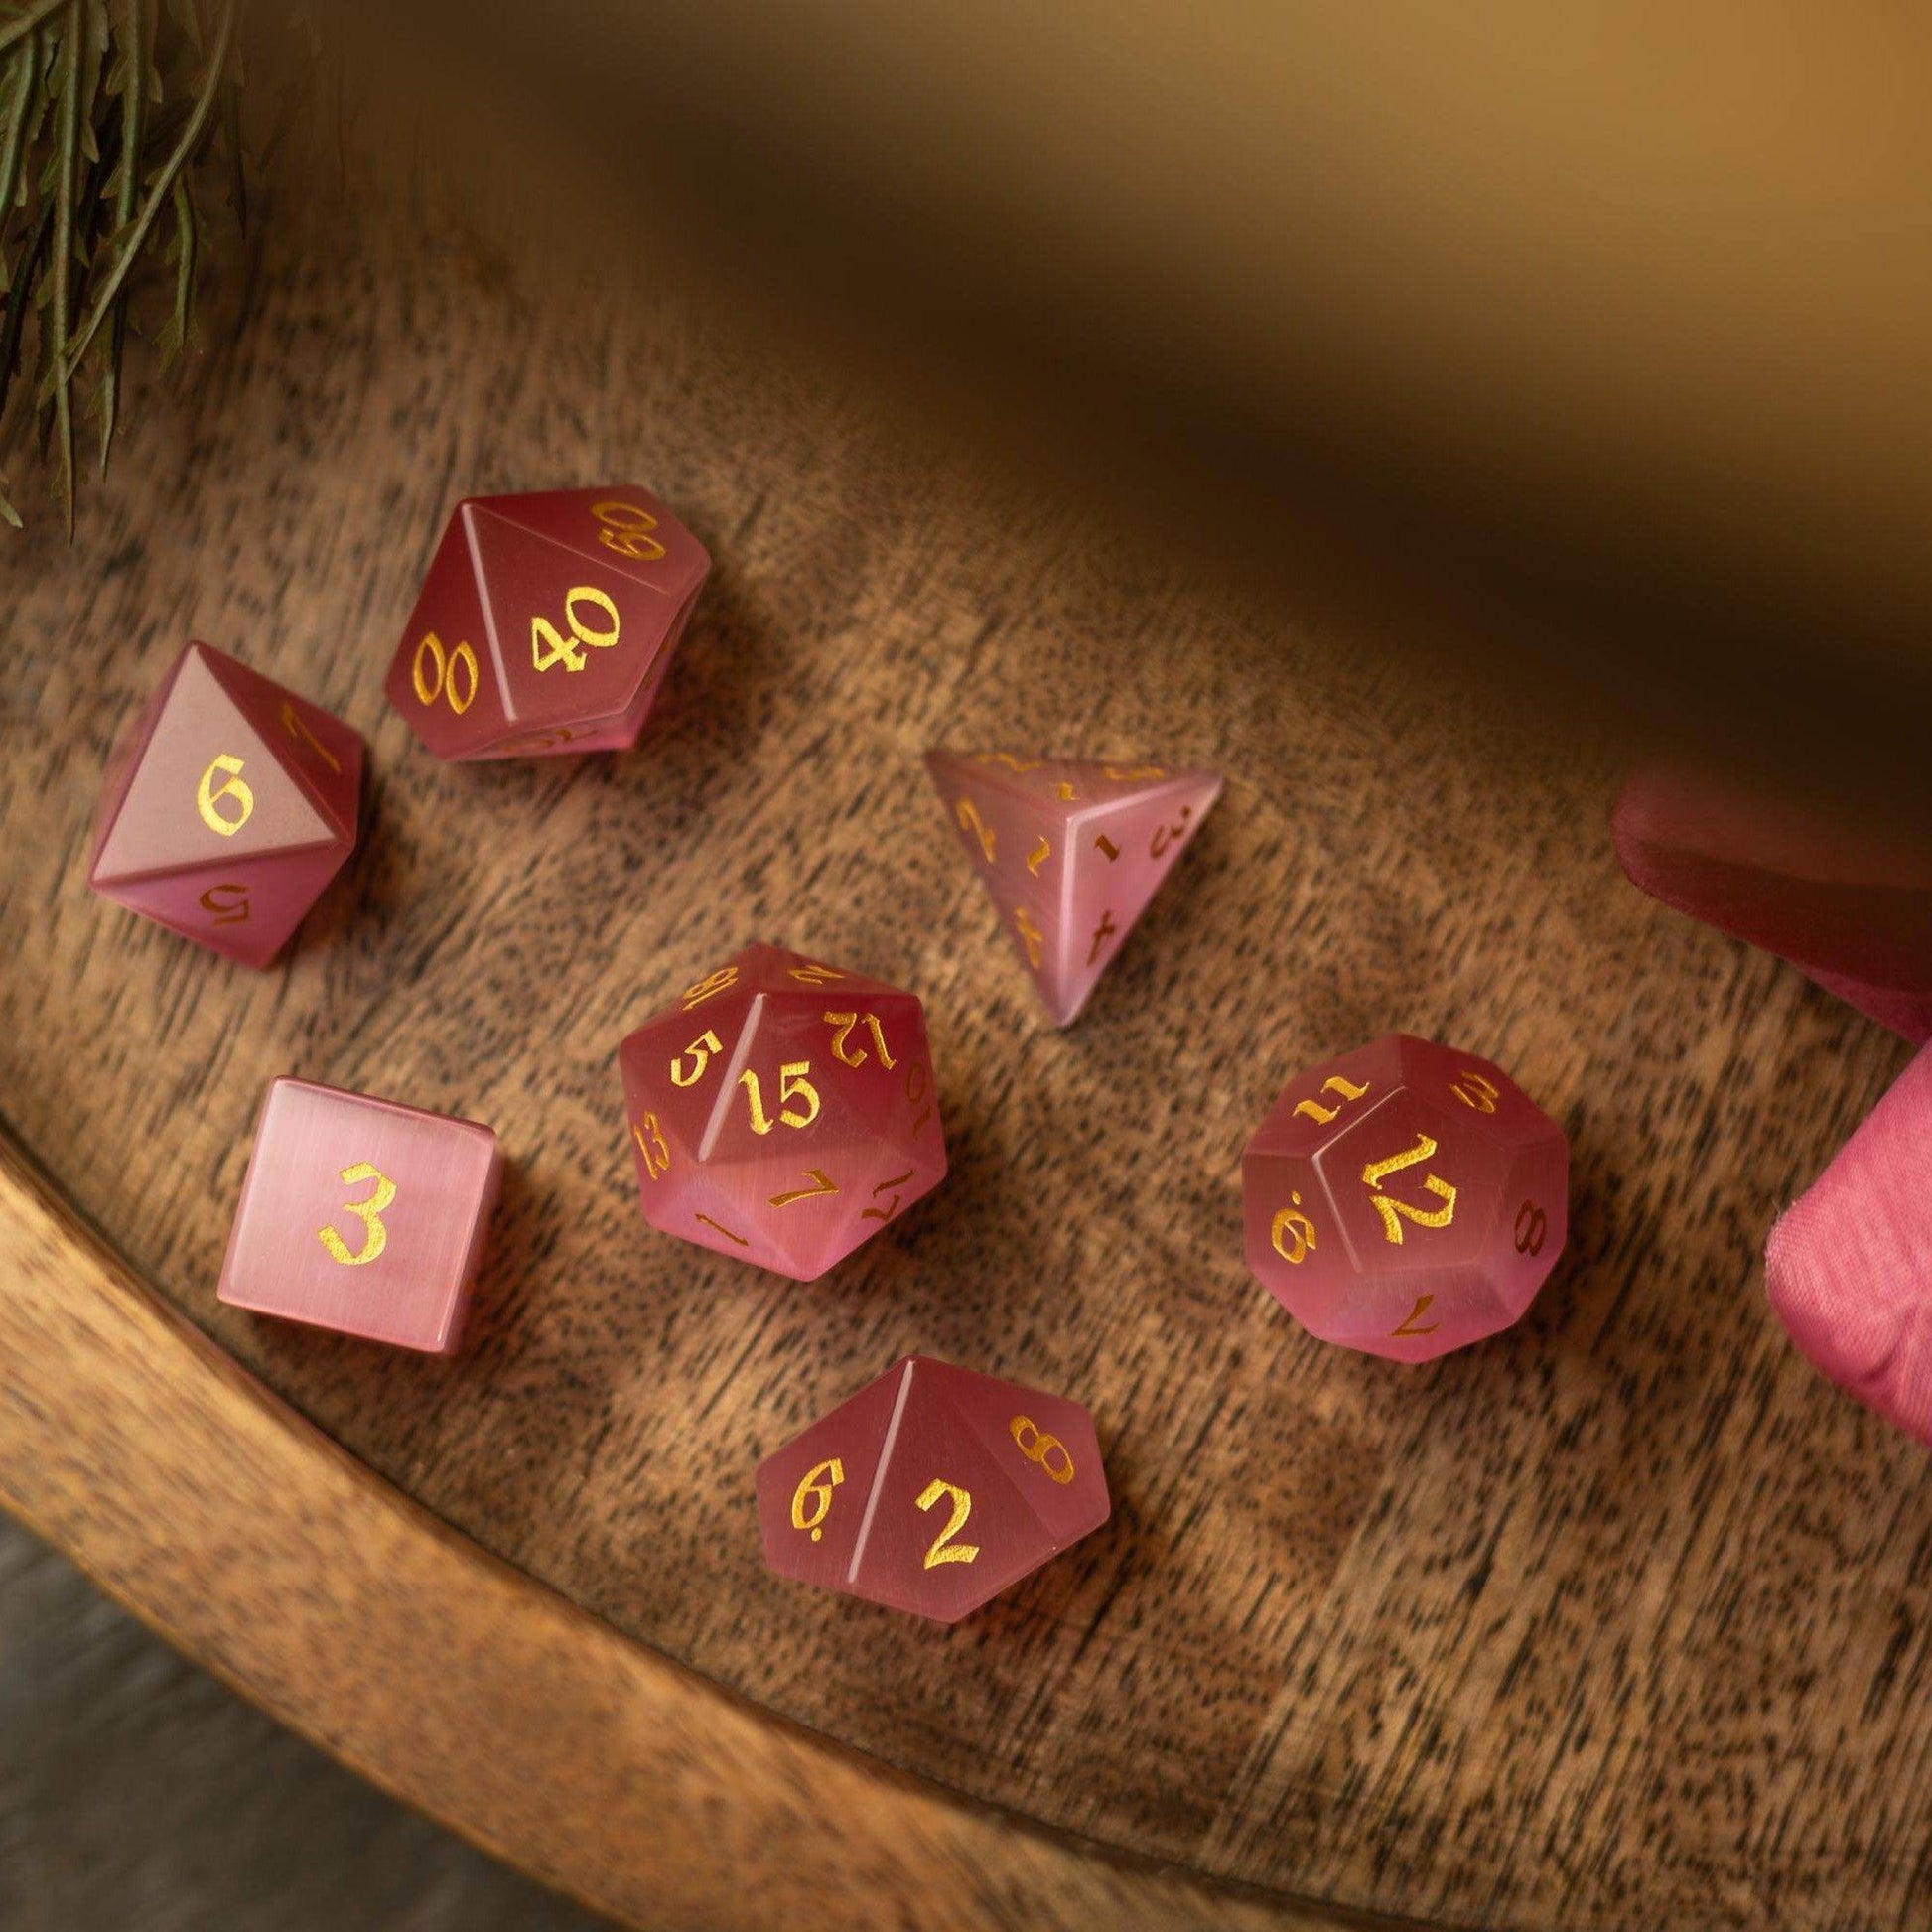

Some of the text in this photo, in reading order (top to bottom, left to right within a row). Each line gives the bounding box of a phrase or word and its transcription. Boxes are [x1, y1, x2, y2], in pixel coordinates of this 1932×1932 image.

[591, 501, 666, 562] 60
[532, 586, 621, 672] 40
[413, 631, 479, 715] 00
[198, 754, 254, 837] 6
[670, 1029, 723, 1087] 5
[738, 1060, 821, 1135] 15
[1293, 1075, 1370, 1126] 11
[634, 1110, 671, 1181] 13
[317, 1160, 398, 1266] 3
[767, 1169, 839, 1208] 7
[1361, 1133, 1457, 1246] 12
[1514, 1198, 1548, 1257] 8
[1008, 1414, 1075, 1485] 8
[915, 1478, 981, 1570] 2
